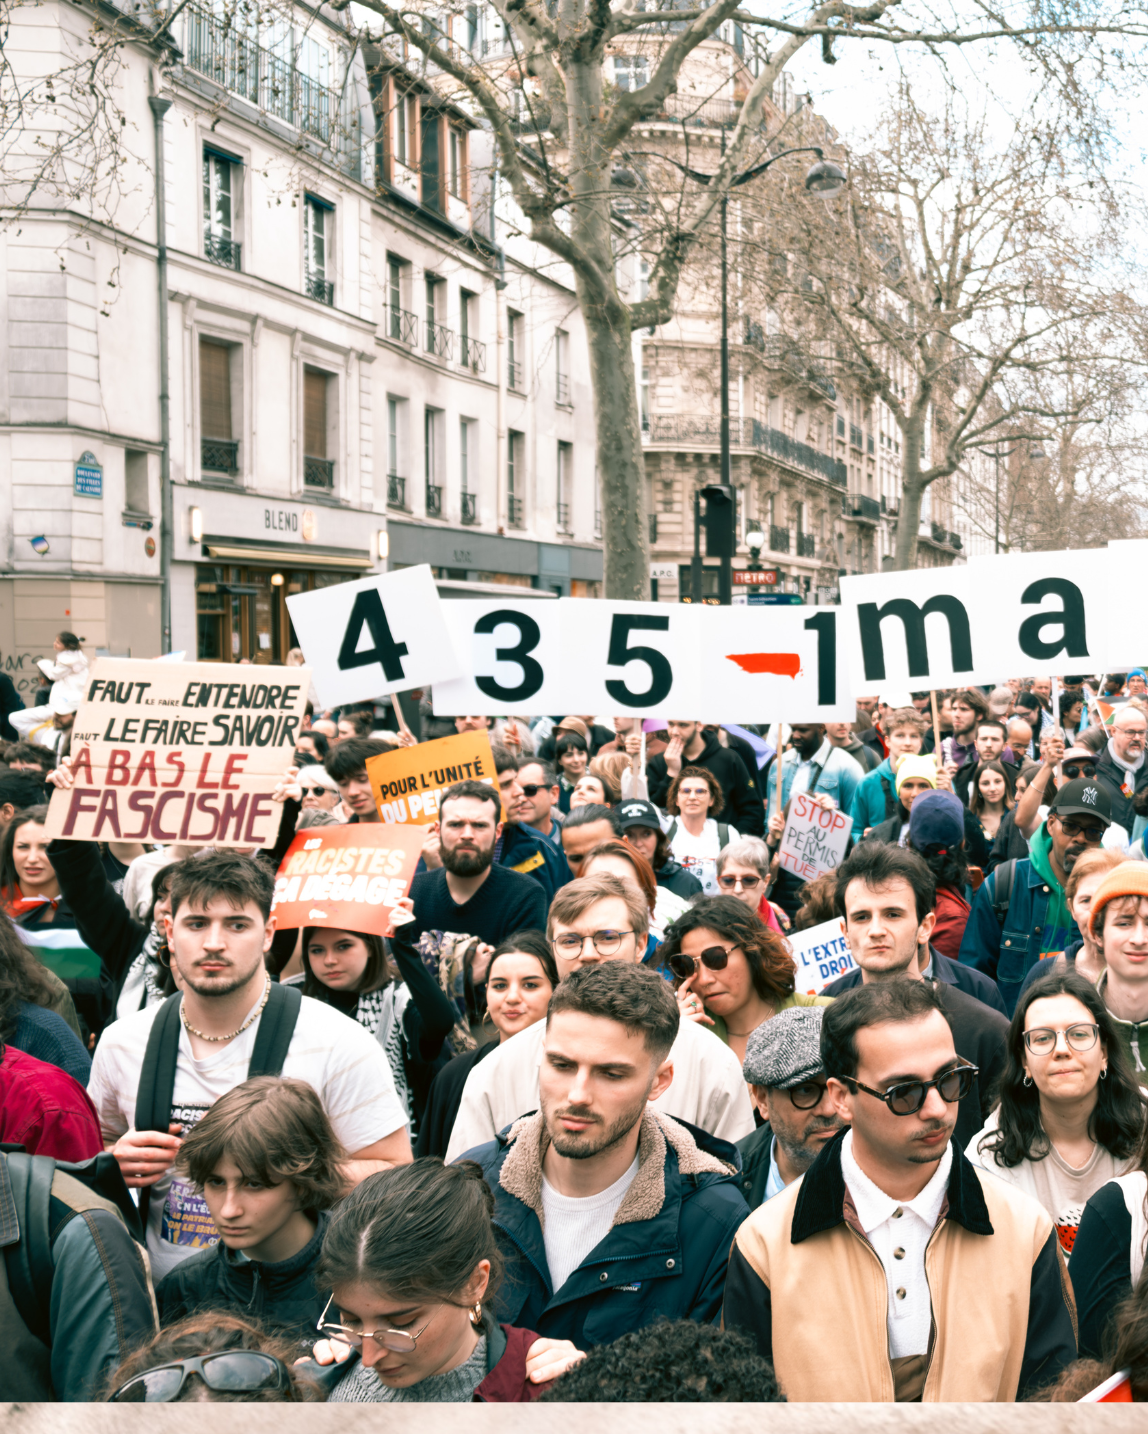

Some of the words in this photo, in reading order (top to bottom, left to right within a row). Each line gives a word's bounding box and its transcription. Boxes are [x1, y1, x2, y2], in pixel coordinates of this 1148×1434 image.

[264, 509, 298, 532] BLEND
[87, 679, 151, 705] FAUT
[182, 682, 300, 710] ENTENDRE
[73, 733, 100, 741] FAUT
[103, 717, 140, 743] LE
[71, 742, 93, 785] À
[104, 749, 186, 788] BAS
[196, 752, 248, 790] LE
[380, 776, 418, 800] POUR
[420, 756, 485, 788] L'UNITÉ
[61, 788, 277, 844] FASCISME
[380, 797, 408, 824] DU
[794, 795, 846, 833] STOP
[787, 826, 838, 868] PERMIS
[806, 825, 827, 842] AU
[284, 847, 406, 876] RACISTES
[801, 853, 817, 867] DE
[298, 867, 408, 907] DÉGAGE
[168, 1220, 181, 1230] ON
[182, 1222, 195, 1233] LE
